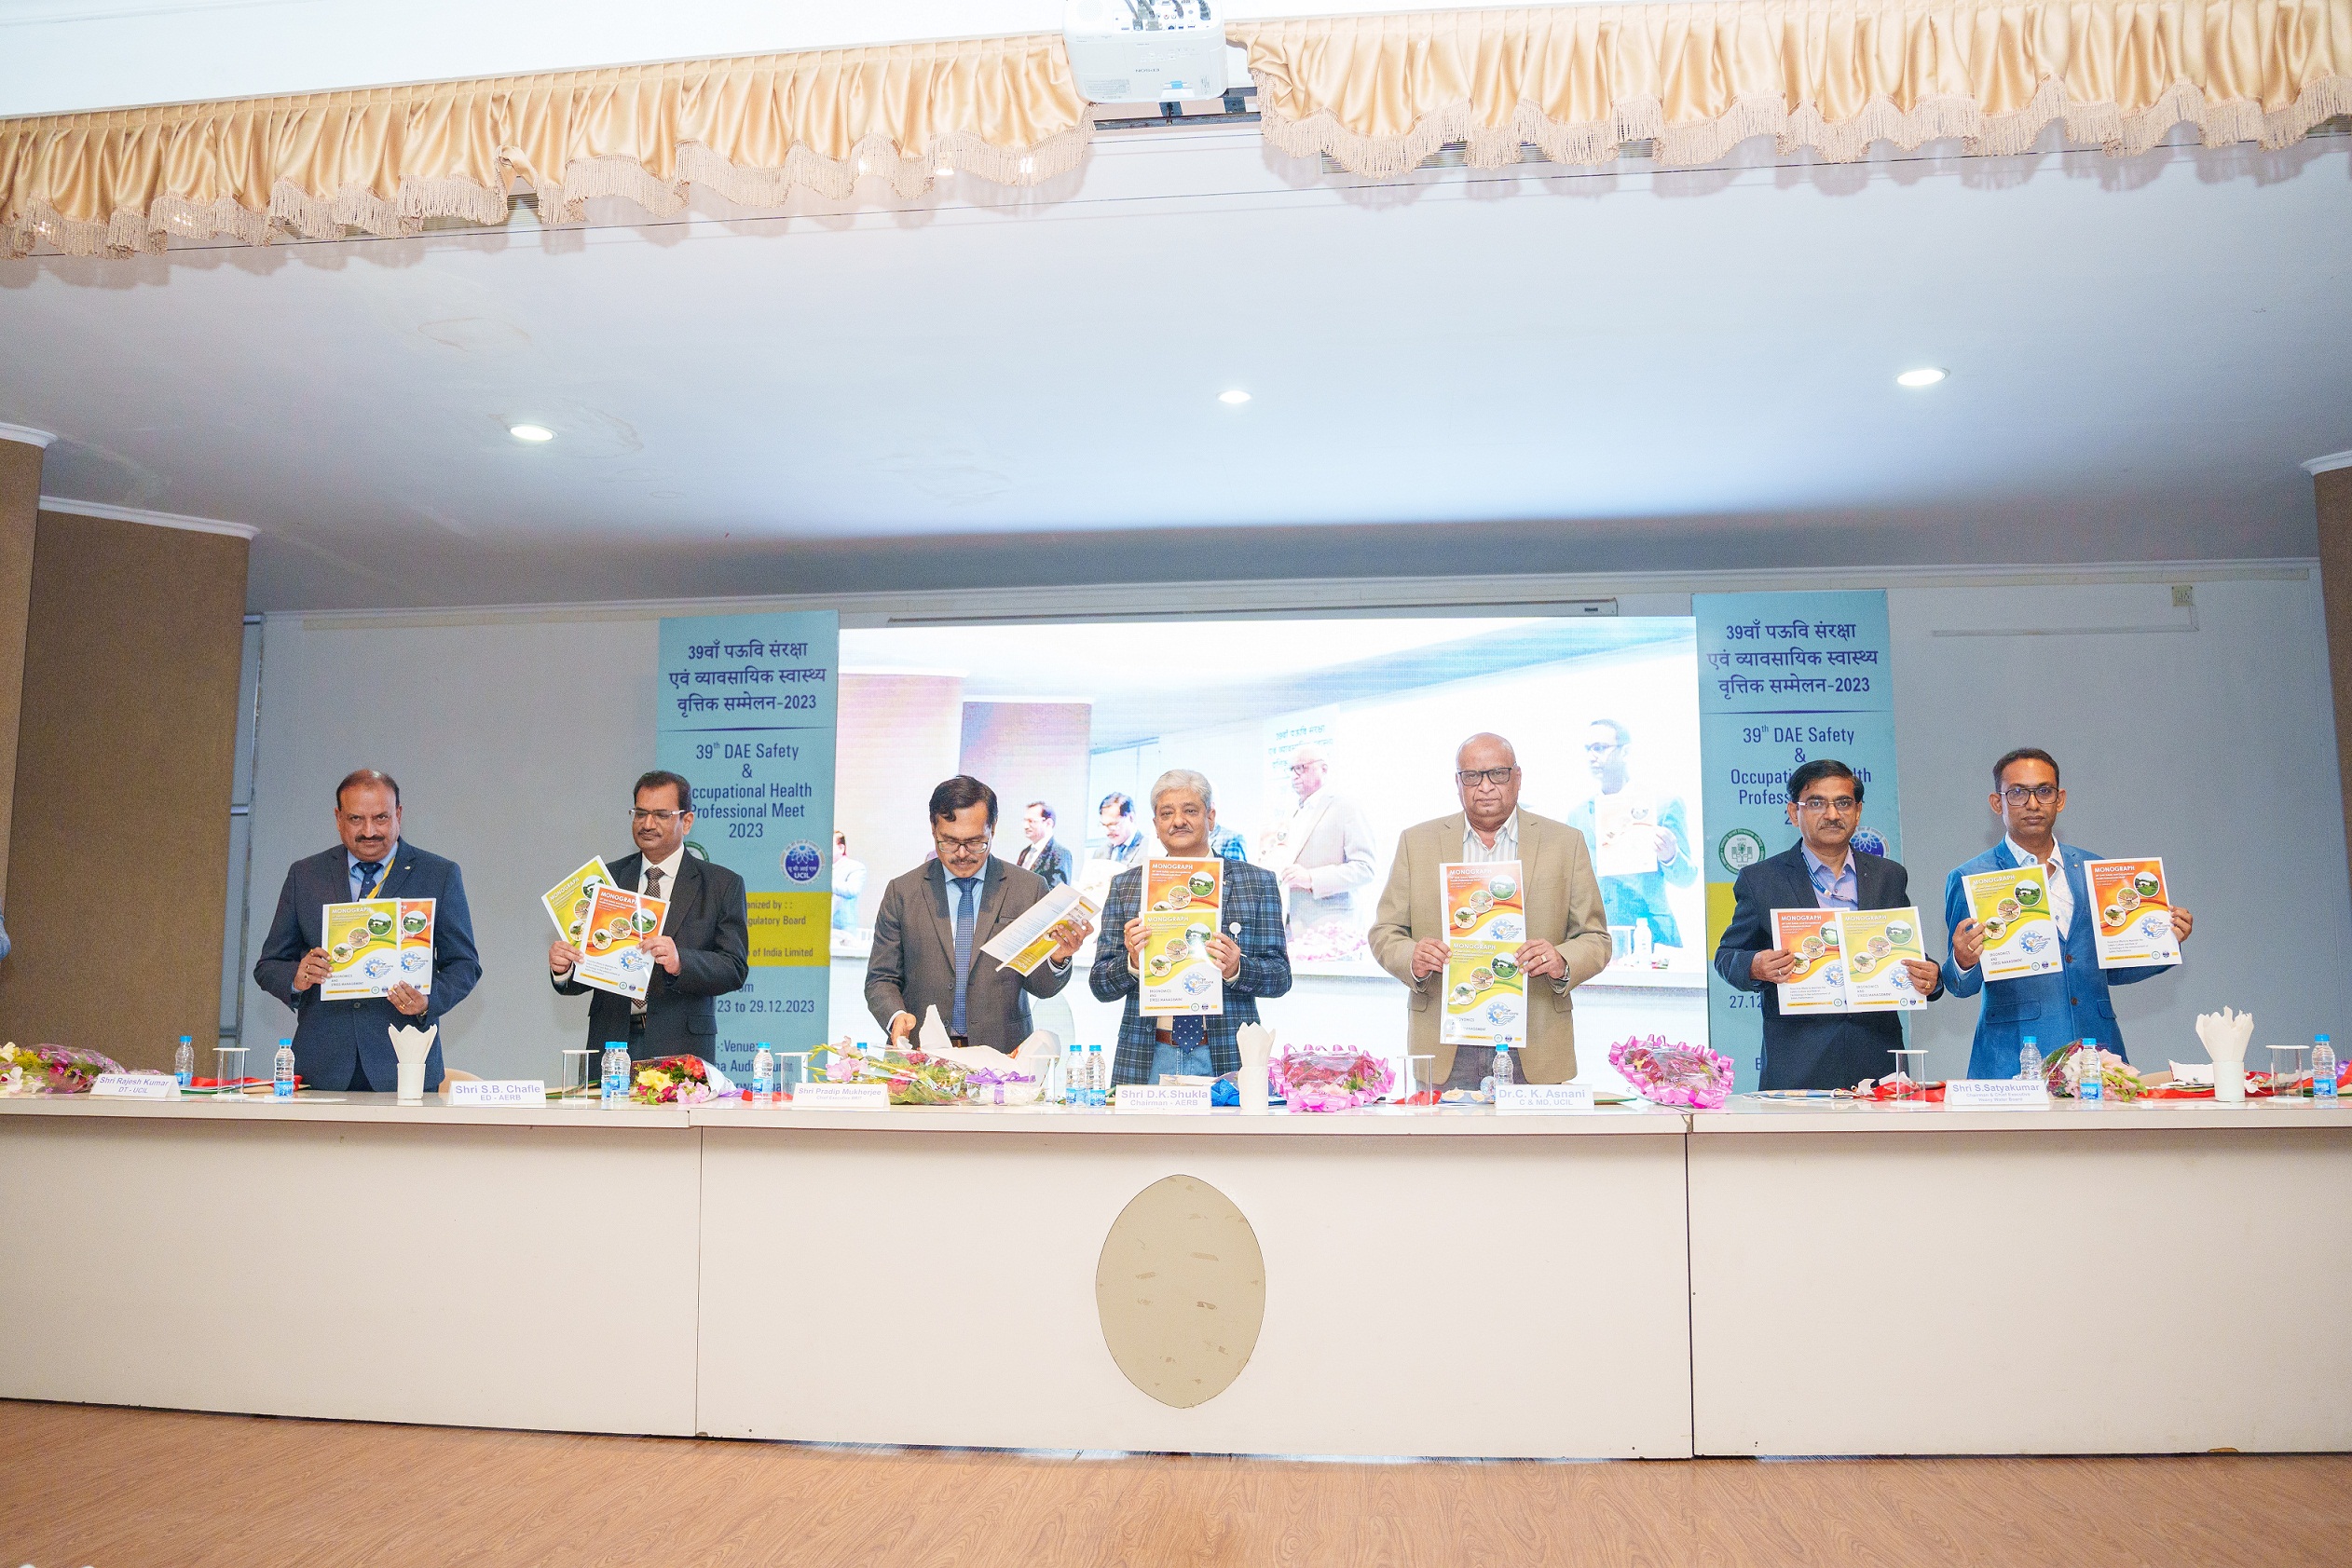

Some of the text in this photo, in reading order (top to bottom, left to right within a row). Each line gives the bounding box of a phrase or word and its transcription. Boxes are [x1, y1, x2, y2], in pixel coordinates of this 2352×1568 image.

[1726, 619, 1856, 641] 39वाँ पऊवि संरक्षा
[688, 639, 808, 660] 39वाँ पऊवि संरक्षा
[1707, 647, 1879, 670] एवं व्यावसायिक स्वास्थ्य
[669, 665, 827, 689] एवं व्यावसायिक स्वास्थ्य
[1718, 673, 1870, 700] वृत्तिक सम्मेलन-2023
[677, 691, 816, 717] वृत्तिक सम्मेलन-2023
[1743, 725, 1854, 745] 39th DAE Safety
[696, 742, 799, 760] 39th DAE Safety
[1795, 747, 1806, 763] &
[742, 763, 753, 779] &
[1731, 769, 1792, 787] Occupati
[691, 783, 812, 802] ccupational Health
[1739, 789, 1790, 805] Profess
[772, 803, 804, 818] Meet
[729, 824, 763, 839] 2023
[1973, 875, 2016, 885] MONOGRAPH
[746, 900, 771, 909] anized
[773, 900, 782, 910] by
[747, 916, 806, 927] gulatory Board
[753, 948, 814, 957] of India Limited
[735, 1002, 745, 1013] to
[749, 1000, 814, 1013] 29.12.2023
[100, 1076, 116, 1084] Shri
[116, 1077, 143, 1086] Rajesh
[455, 1084, 540, 1094] Shri S.B. Chafle
[1975, 1084, 2040, 1094] S.Satyakumar
[1121, 1090, 1209, 1099] Shri D.K.Shukla
[1530, 1090, 1542, 1098] K.
[1546, 1090, 1586, 1098] Asnani
